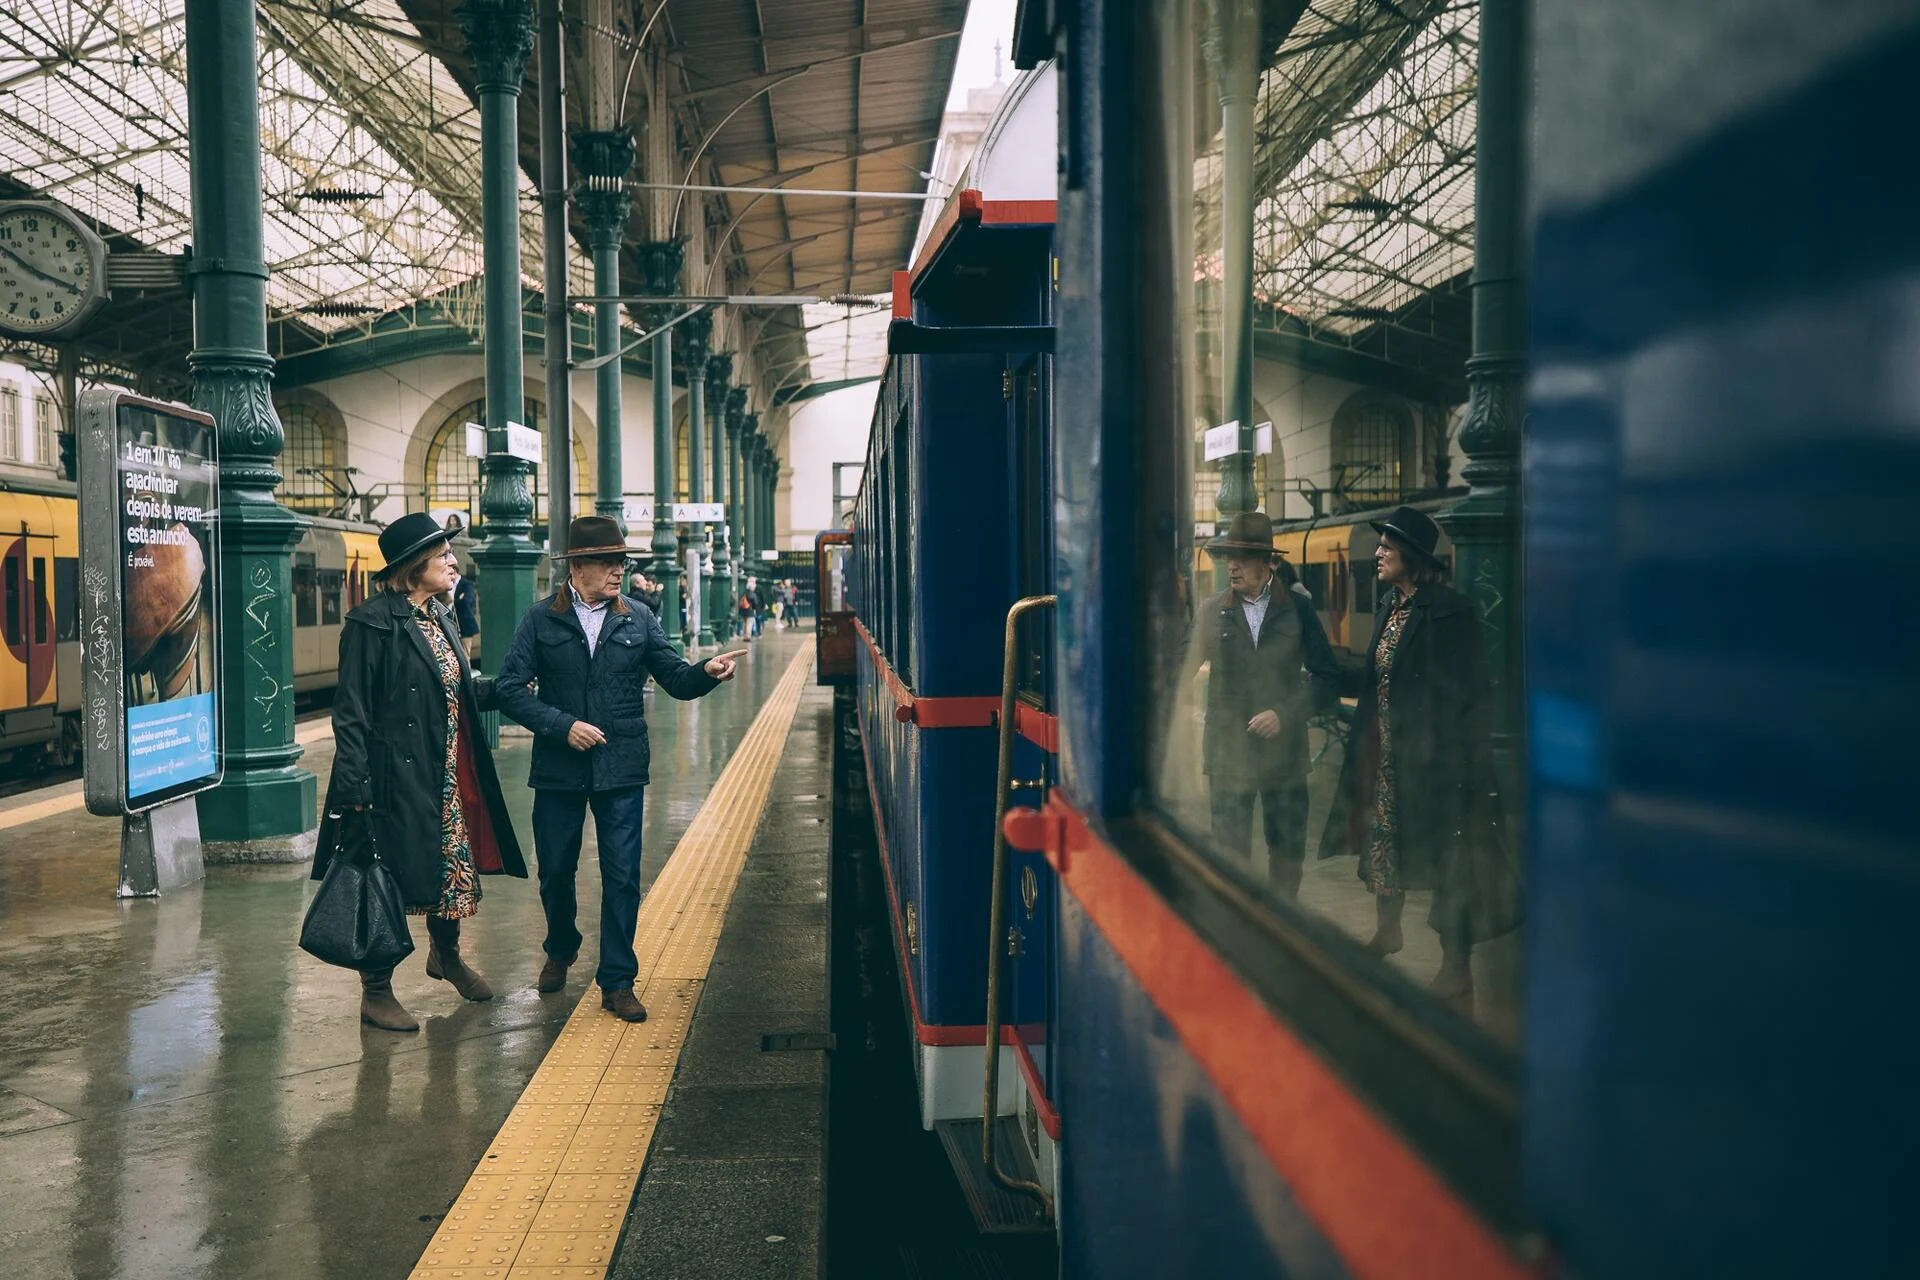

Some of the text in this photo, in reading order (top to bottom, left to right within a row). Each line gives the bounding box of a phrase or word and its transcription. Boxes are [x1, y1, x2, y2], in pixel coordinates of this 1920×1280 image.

[21, 219, 39, 232] 12
[50, 226, 57, 238] 1
[0, 227, 12, 240] 11
[65, 239, 77, 252] 2
[74, 263, 84, 276] 3
[8, 302, 19, 313] 7
[30, 308, 40, 320] 6
[54, 301, 64, 314] 5
[126, 440, 181, 470] 1 em 10 vão
[127, 497, 202, 521] depois de verem
[642, 508, 649, 516] A
[678, 508, 685, 517] A
[127, 525, 149, 544] este
[128, 551, 133, 567] É
